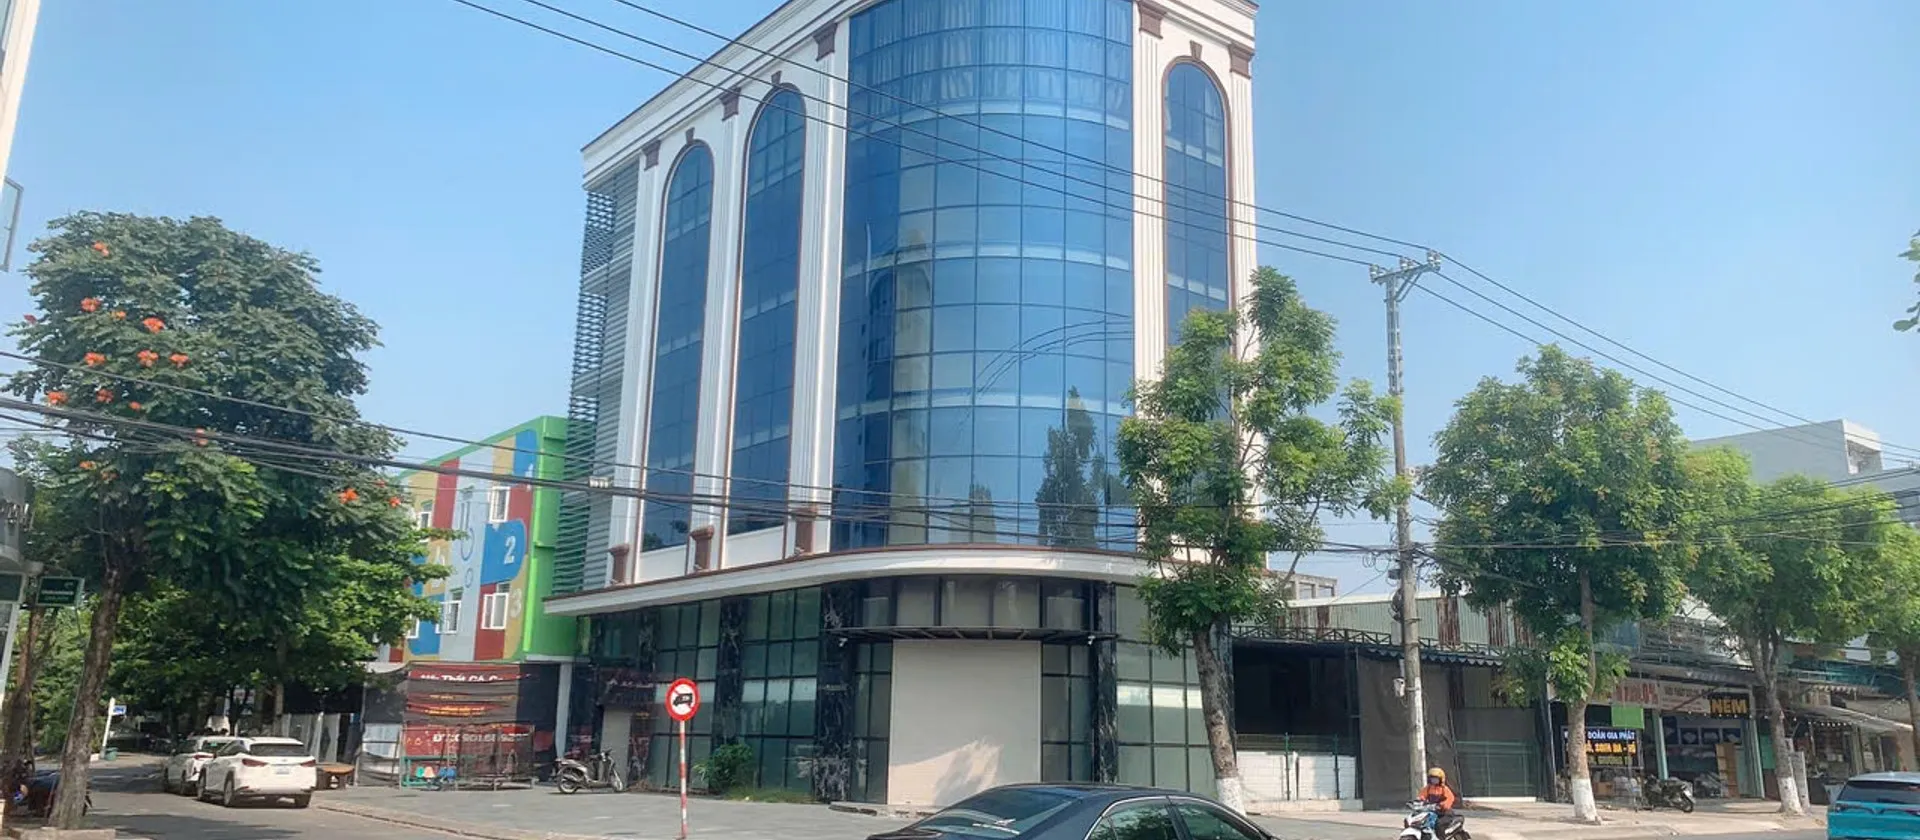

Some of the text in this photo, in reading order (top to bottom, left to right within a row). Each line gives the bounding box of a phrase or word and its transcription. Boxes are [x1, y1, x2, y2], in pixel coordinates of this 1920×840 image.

[503, 535, 516, 564] 2
[510, 588, 522, 618] 3
[1607, 731, 1618, 739] GIA
